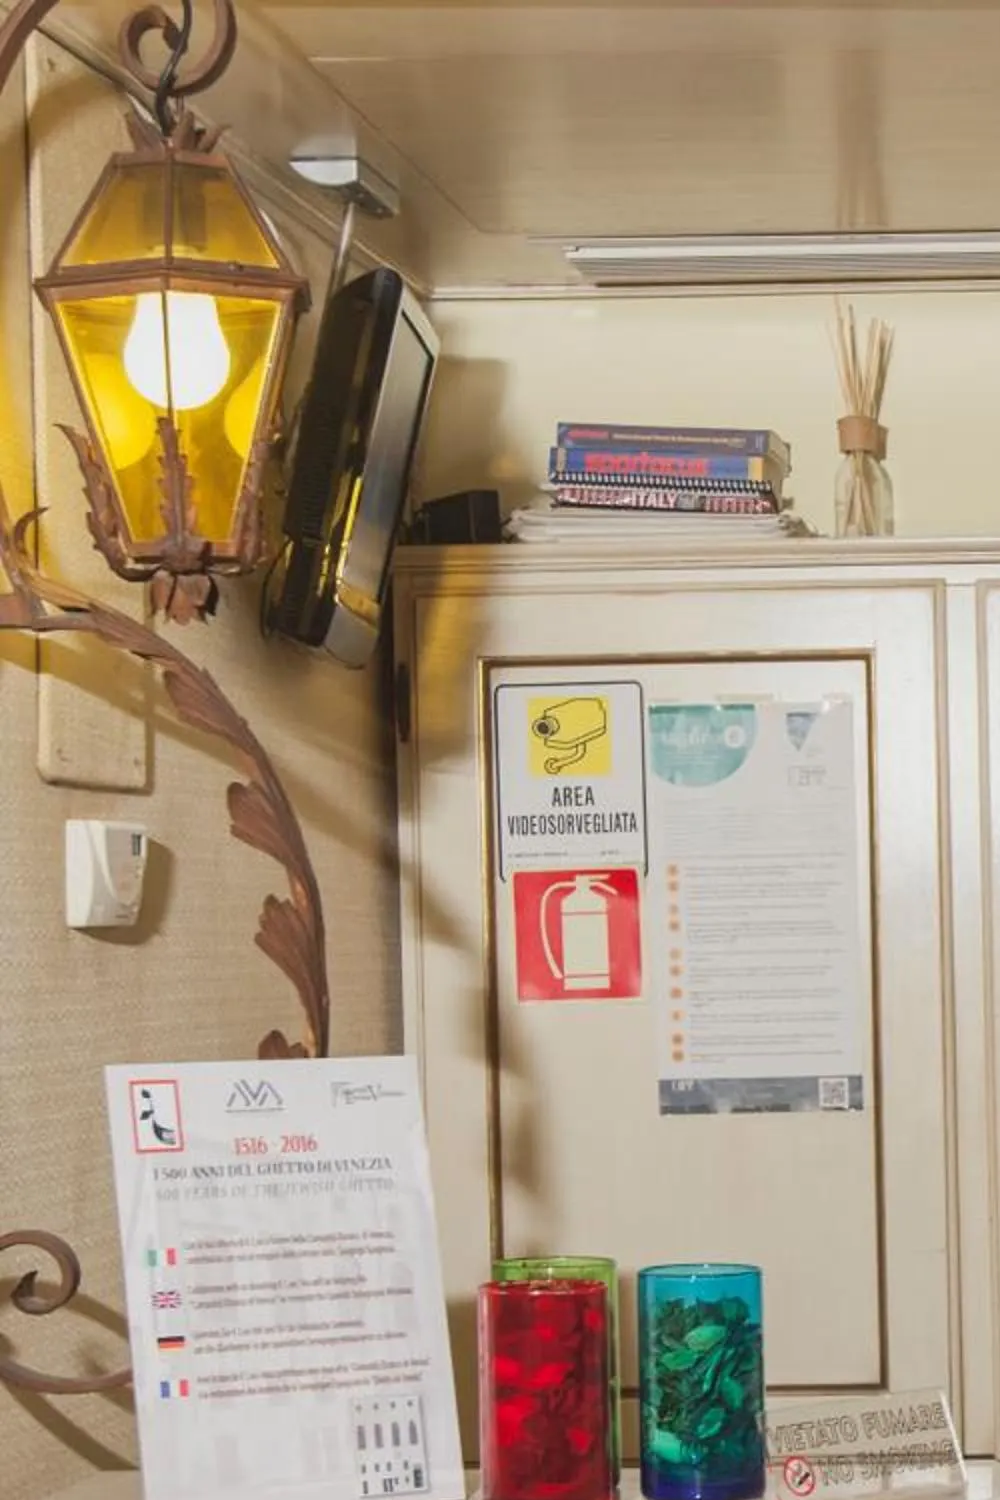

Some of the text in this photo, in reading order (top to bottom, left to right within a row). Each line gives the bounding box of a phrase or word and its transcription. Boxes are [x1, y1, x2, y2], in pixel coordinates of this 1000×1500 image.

[631, 488, 678, 509] ITALY
[551, 785, 595, 807] AREA
[507, 812, 638, 836] VIDEOSORVEGLIATA
[234, 1136, 268, 1155] 1516
[280, 1134, 318, 1153] 2016
[161, 1165, 187, 1181] 500
[189, 1163, 225, 1180] ANNI
[228, 1162, 251, 1178] DEL
[256, 1159, 315, 1176] GHETTO
[317, 1159, 332, 1174] DI
[333, 1156, 392, 1173] VENEZIA
[768, 1402, 948, 1453] VIETATO FUMARE
[819, 1455, 856, 1486] NO
